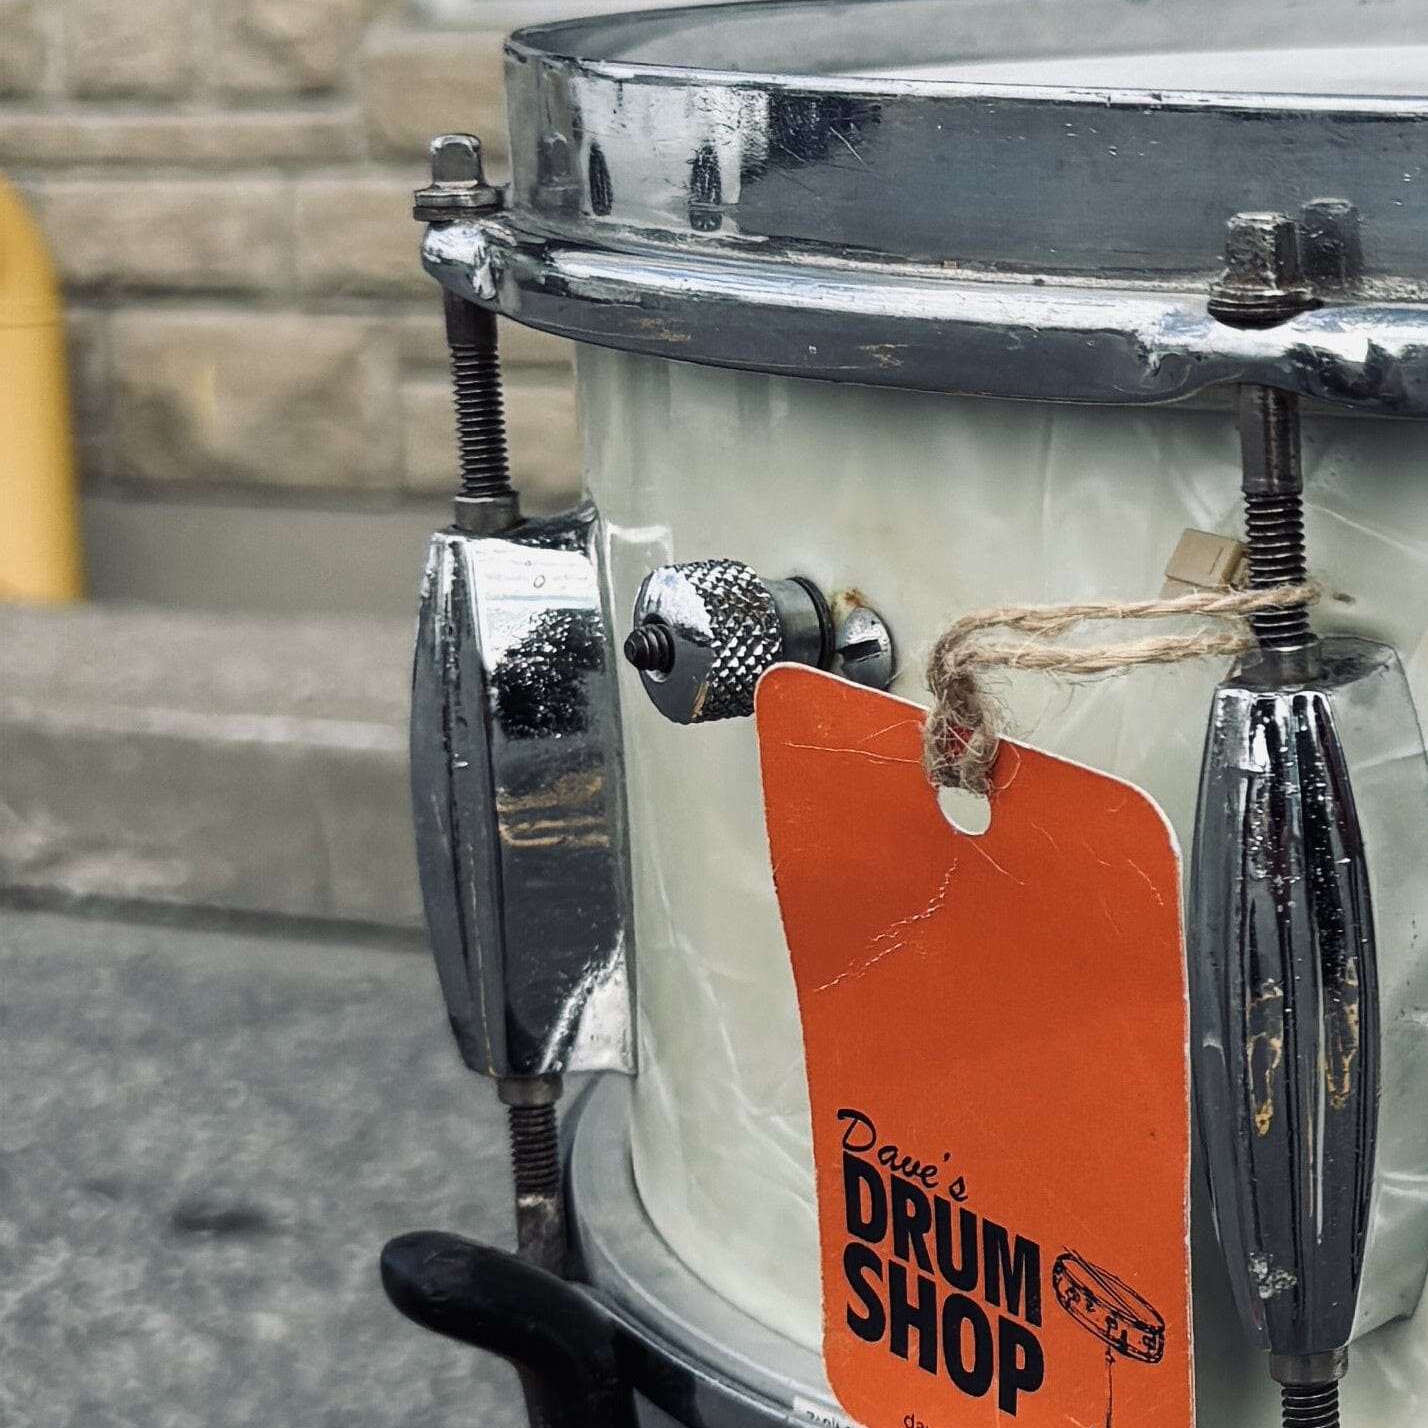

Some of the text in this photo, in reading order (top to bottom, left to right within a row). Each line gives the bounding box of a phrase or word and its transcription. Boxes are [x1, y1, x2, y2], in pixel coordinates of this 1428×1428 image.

[836, 1107, 970, 1204] Dave's
[842, 1149, 1044, 1329] DRUM
[842, 1240, 1047, 1418] SHOP
